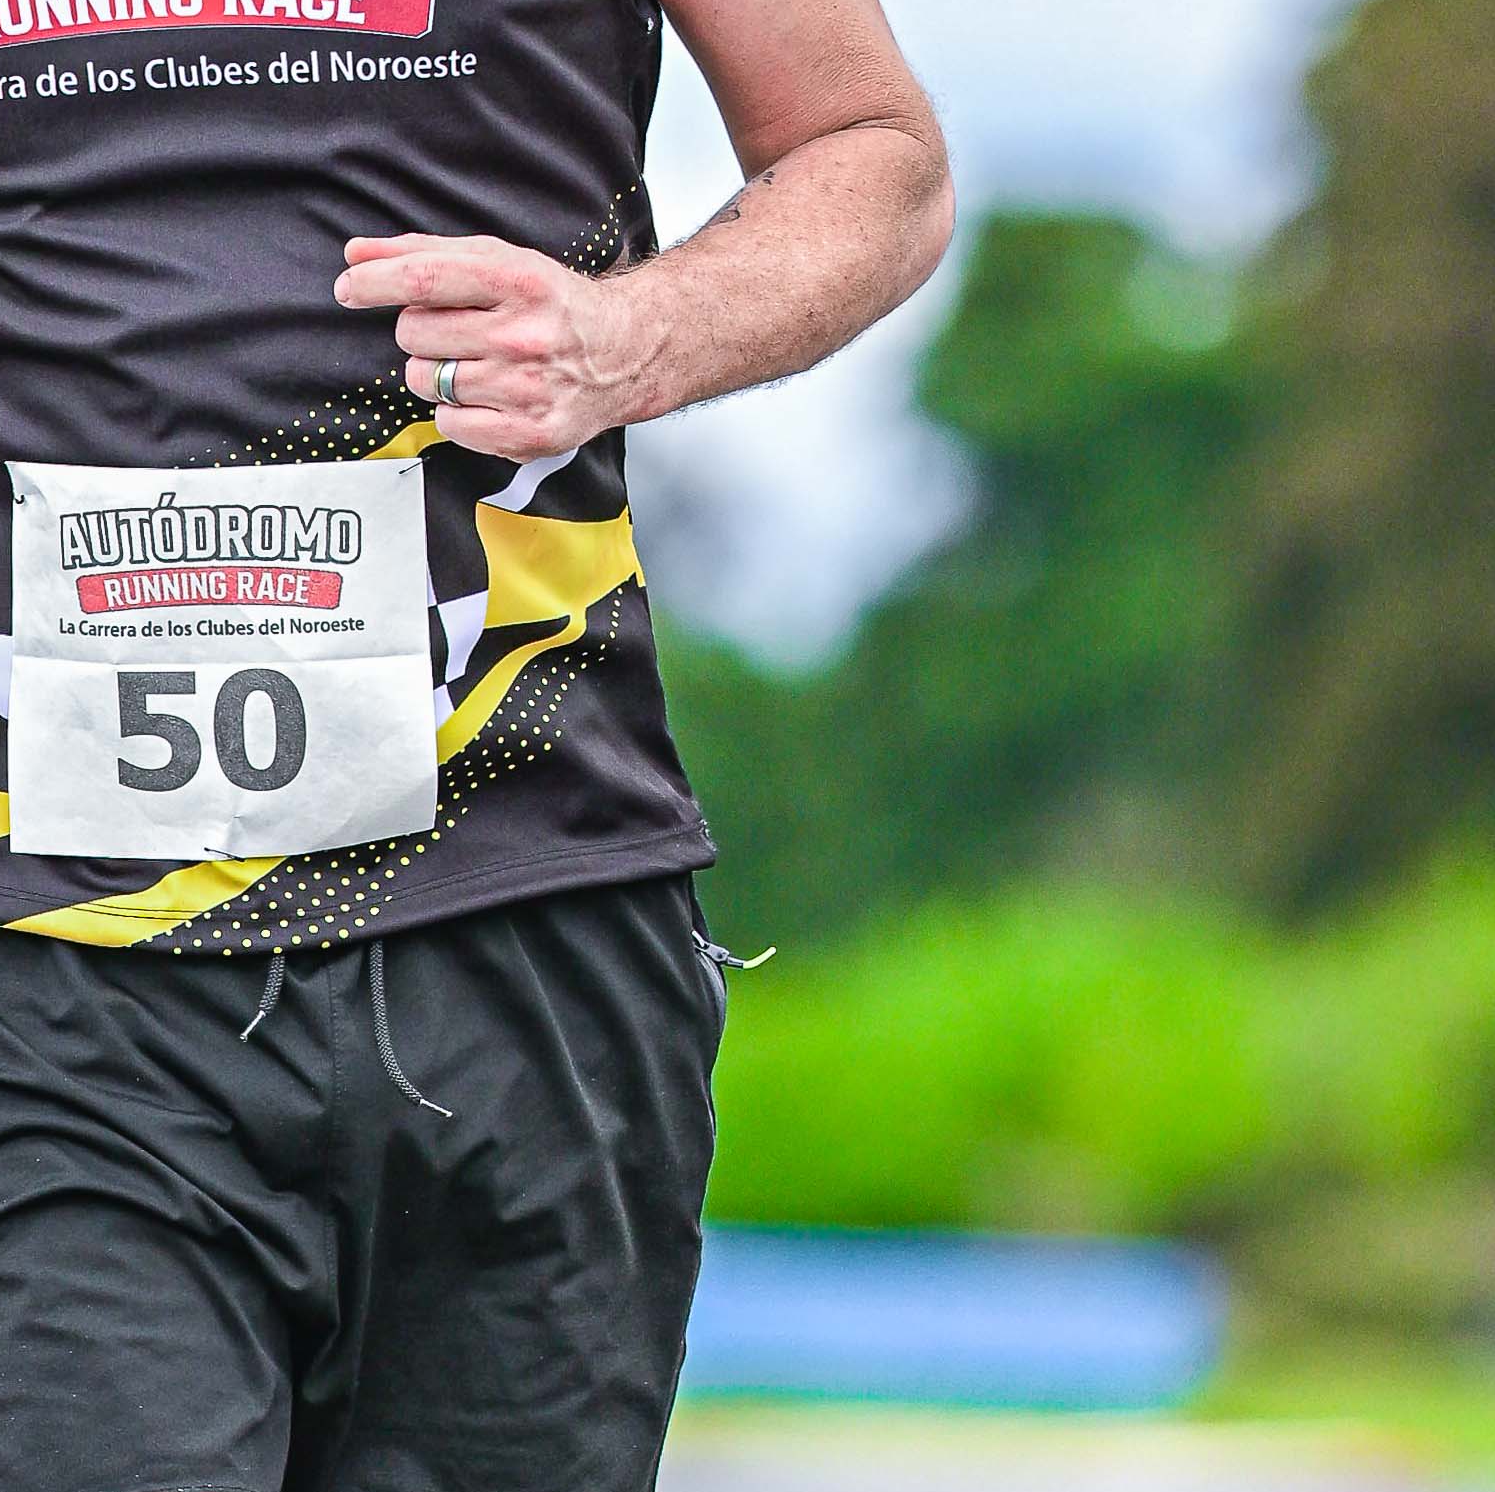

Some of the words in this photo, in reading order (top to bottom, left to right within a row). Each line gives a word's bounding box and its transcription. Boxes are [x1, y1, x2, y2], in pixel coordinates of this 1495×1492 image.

[36, 64, 78, 97] de
[86, 61, 137, 93] los
[145, 55, 260, 89] Clubes
[268, 50, 320, 84] del
[329, 49, 478, 82] Noroeste
[60, 492, 361, 569] AUTÓDROMO
[104, 571, 227, 607] RUNNING
[237, 570, 310, 604] RACE
[59, 618, 75, 635] La
[79, 620, 136, 637] Carrera
[141, 620, 163, 637] de
[168, 619, 192, 636] los
[196, 619, 254, 635] Clubes
[259, 618, 285, 634] del
[290, 617, 365, 634] Noroeste
[117, 667, 307, 792] 50
